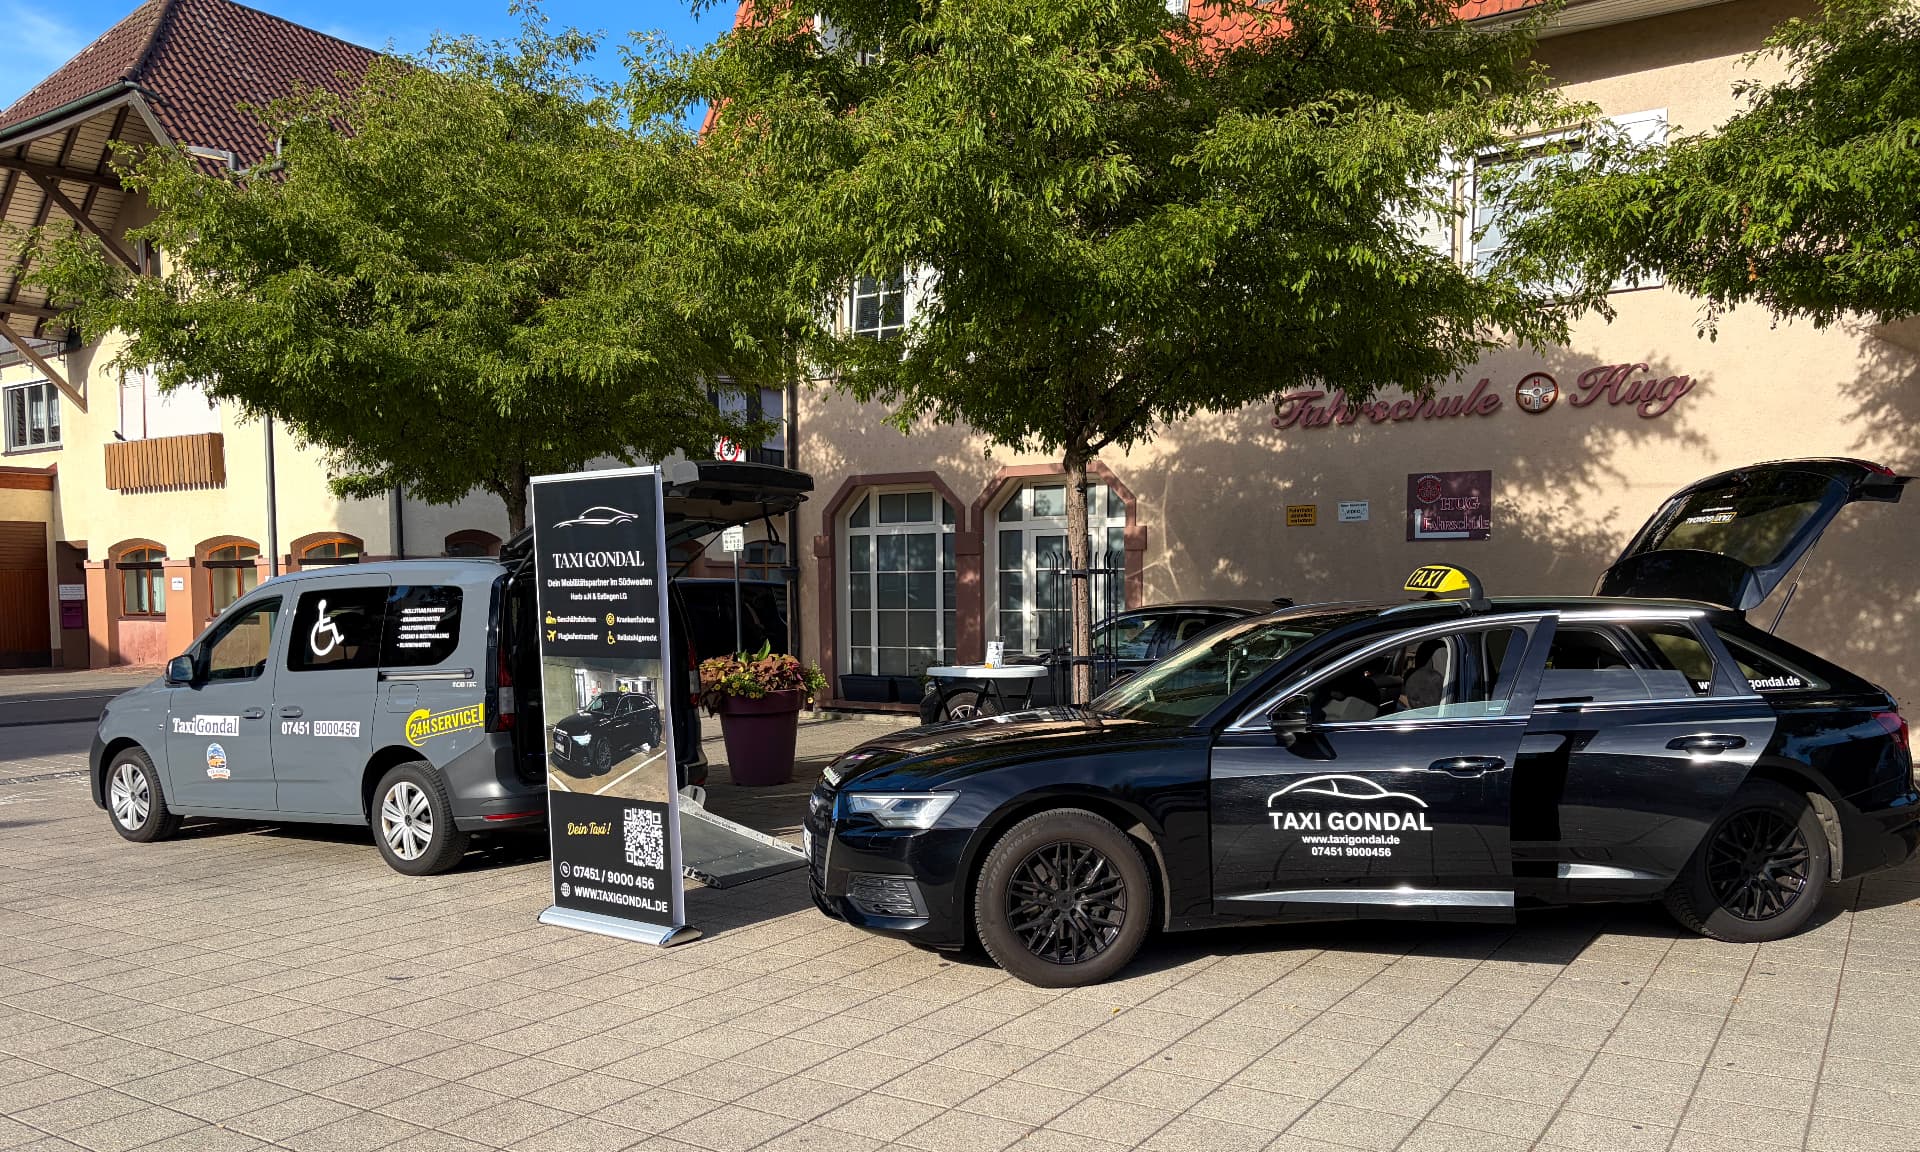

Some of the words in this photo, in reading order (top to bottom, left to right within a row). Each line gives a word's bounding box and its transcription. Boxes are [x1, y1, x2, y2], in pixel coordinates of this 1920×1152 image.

[1271, 378, 1503, 430] Fahrschule
[1569, 362, 1697, 418] Hug
[1440, 496, 1481, 511] HUG
[552, 552, 584, 569] TAXI
[585, 550, 645, 568] GONDAL
[547, 579, 561, 588] Dein
[561, 578, 609, 589] Mobilitätspartner
[609, 577, 618, 586] im
[618, 577, 653, 586] Südwesten
[1409, 570, 1446, 587] TAXI
[281, 721, 310, 735] 07451
[315, 722, 357, 735] 9000456
[411, 720, 431, 738] 24H
[567, 822, 589, 836] Dein
[1268, 812, 1321, 830] TAXI
[1327, 812, 1434, 831] GONDAL
[1302, 834, 1400, 846] www.taxigondal.de
[1311, 847, 1343, 856] 07451
[1345, 847, 1392, 857] 9000456
[573, 865, 601, 881] 07451
[601, 869, 606, 884] /
[607, 871, 634, 887] 9000
[635, 876, 655, 891] 456
[574, 885, 669, 913] WWW.TAXIGONDAL.DE
